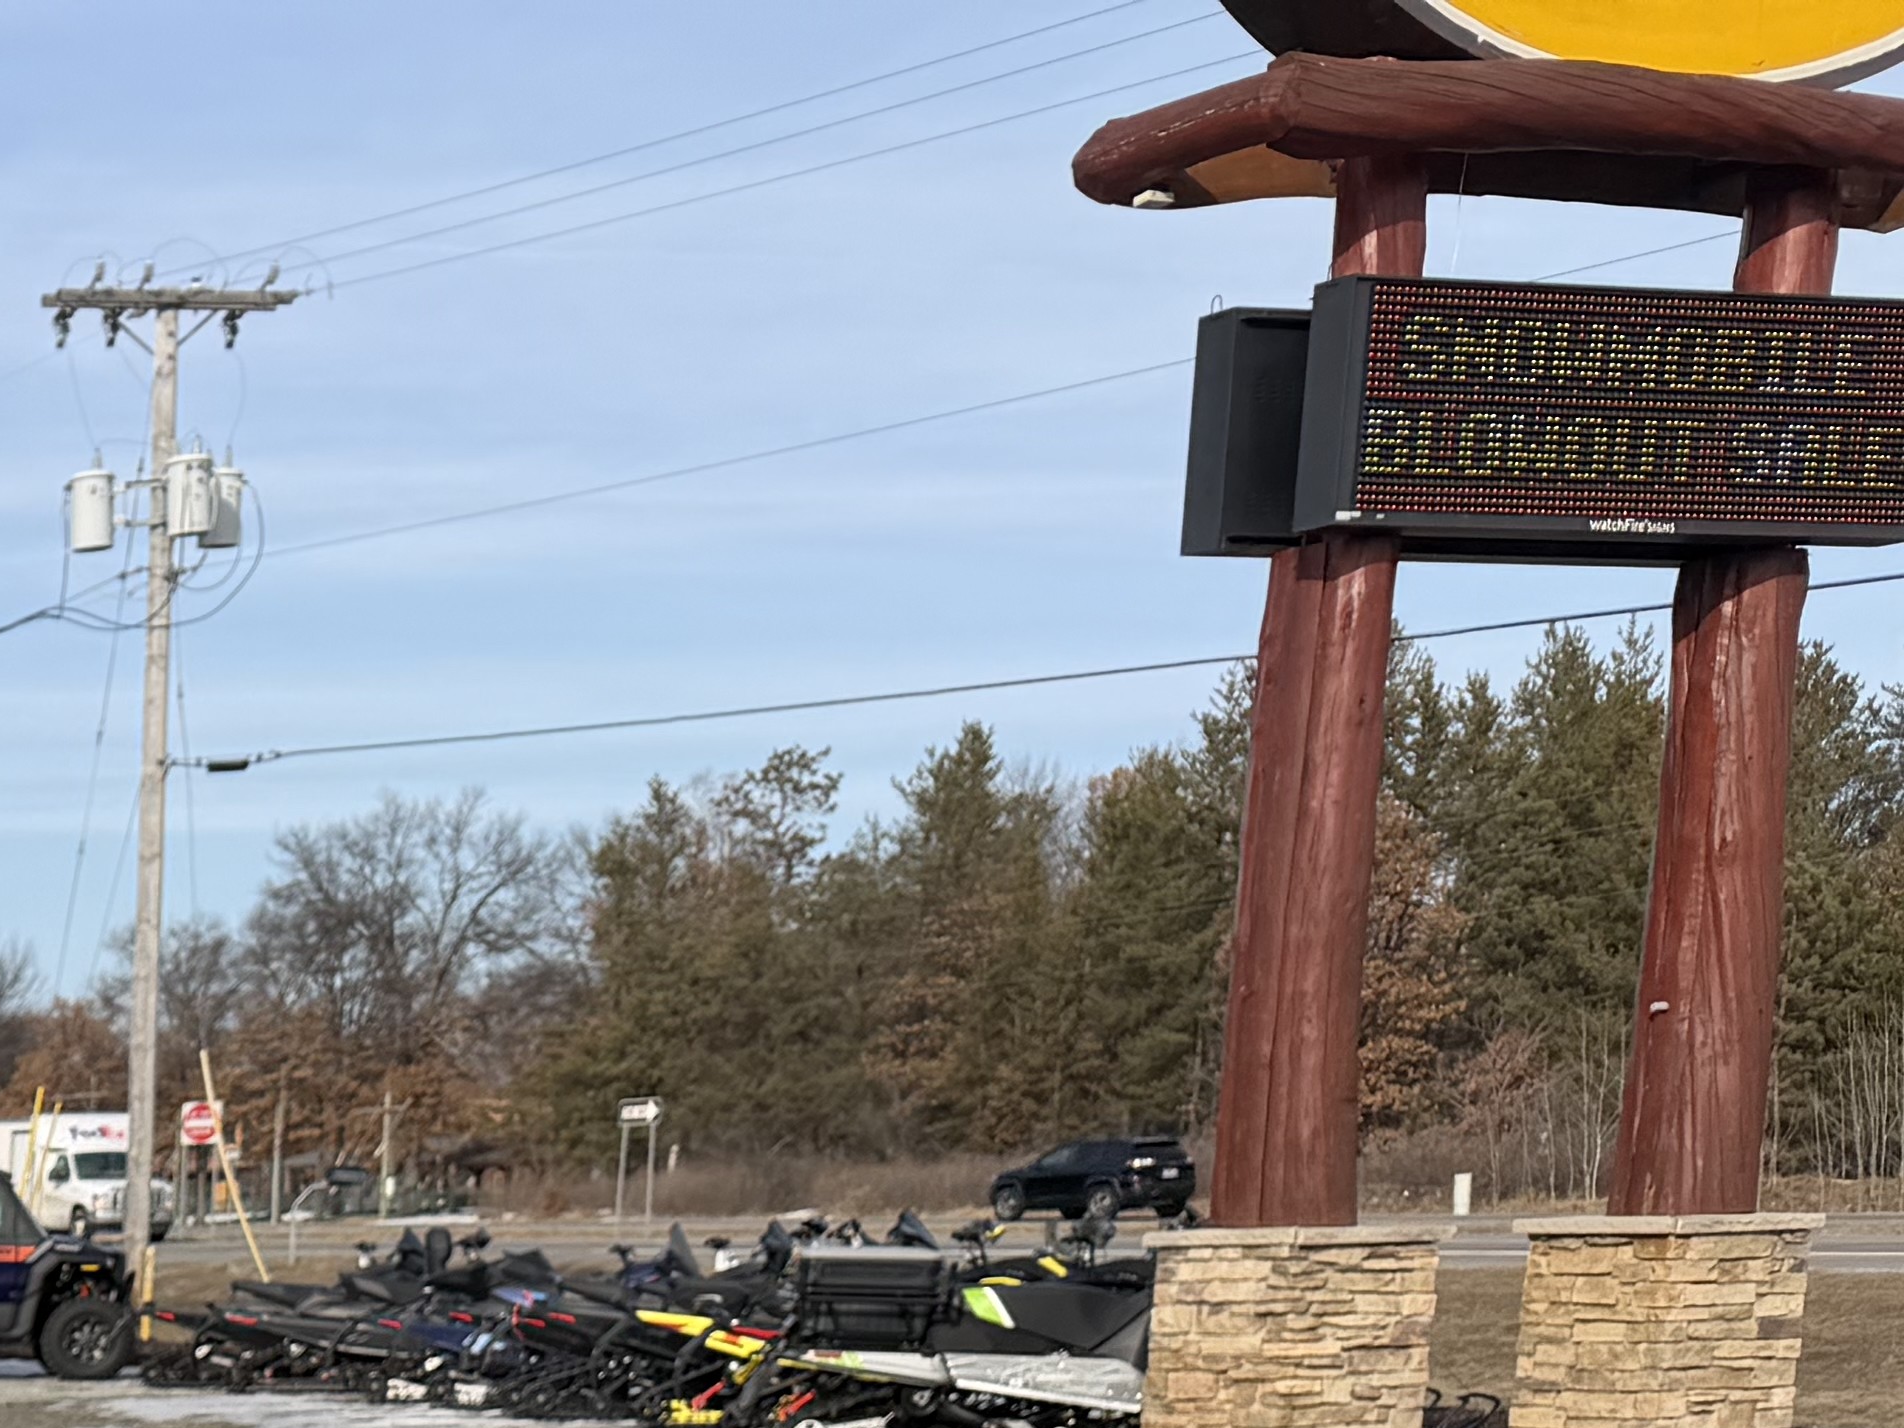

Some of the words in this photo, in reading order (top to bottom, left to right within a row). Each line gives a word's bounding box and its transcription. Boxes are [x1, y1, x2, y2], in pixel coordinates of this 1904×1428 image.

[1402, 316, 1875, 396] SNOWMOBILE
[1363, 408, 1705, 483] BLOWOUT
[1730, 422, 1903, 488] SALE
